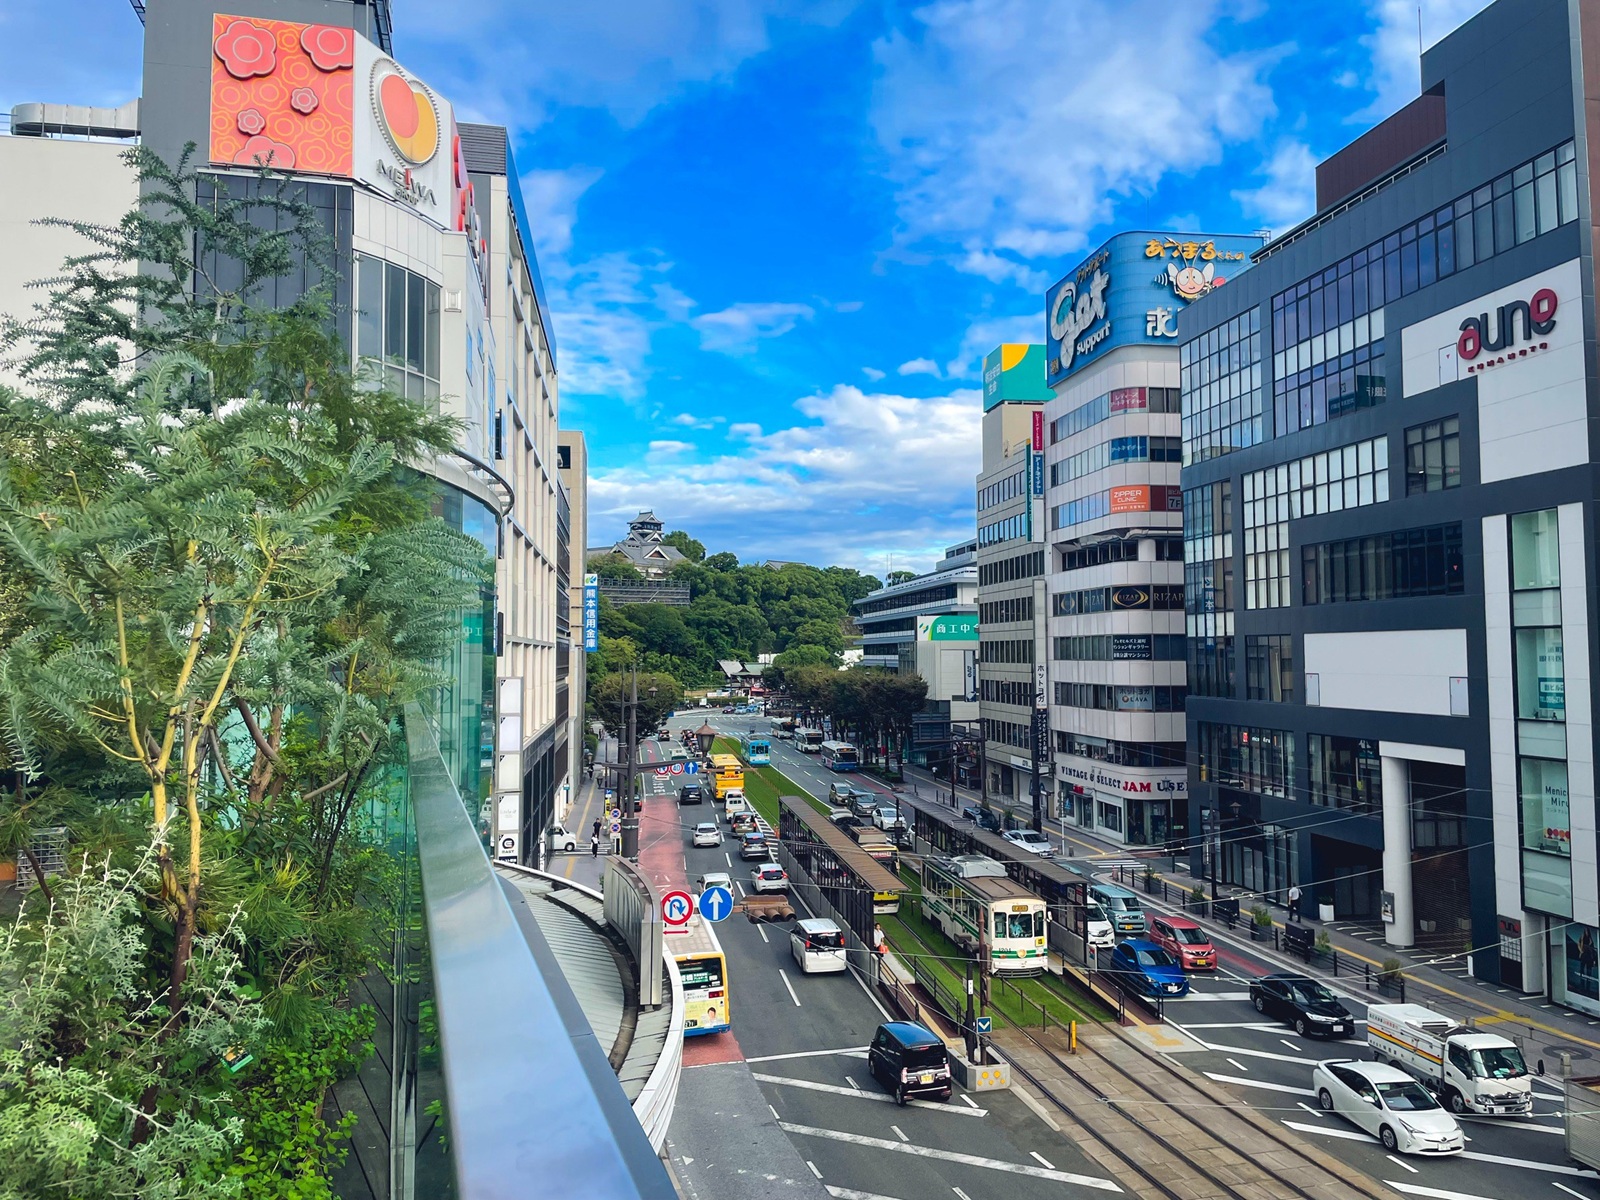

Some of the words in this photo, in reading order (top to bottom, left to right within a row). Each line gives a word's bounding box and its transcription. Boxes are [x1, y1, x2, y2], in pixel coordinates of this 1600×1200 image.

[376, 158, 437, 206] MEIWA
[1076, 319, 1111, 356] support
[1458, 288, 1558, 360] aune
[1468, 342, 1548, 373] KUMAMOTO
[1153, 592, 1184, 602] RIZAP
[586, 589, 596, 648] 熊本信用金庫
[673, 764, 681, 774] 40
[1061, 766, 1088, 780] VINTAGE
[1097, 775, 1121, 789] SELECT
[1123, 781, 1151, 793] JAM
[1157, 782, 1188, 792] USE
